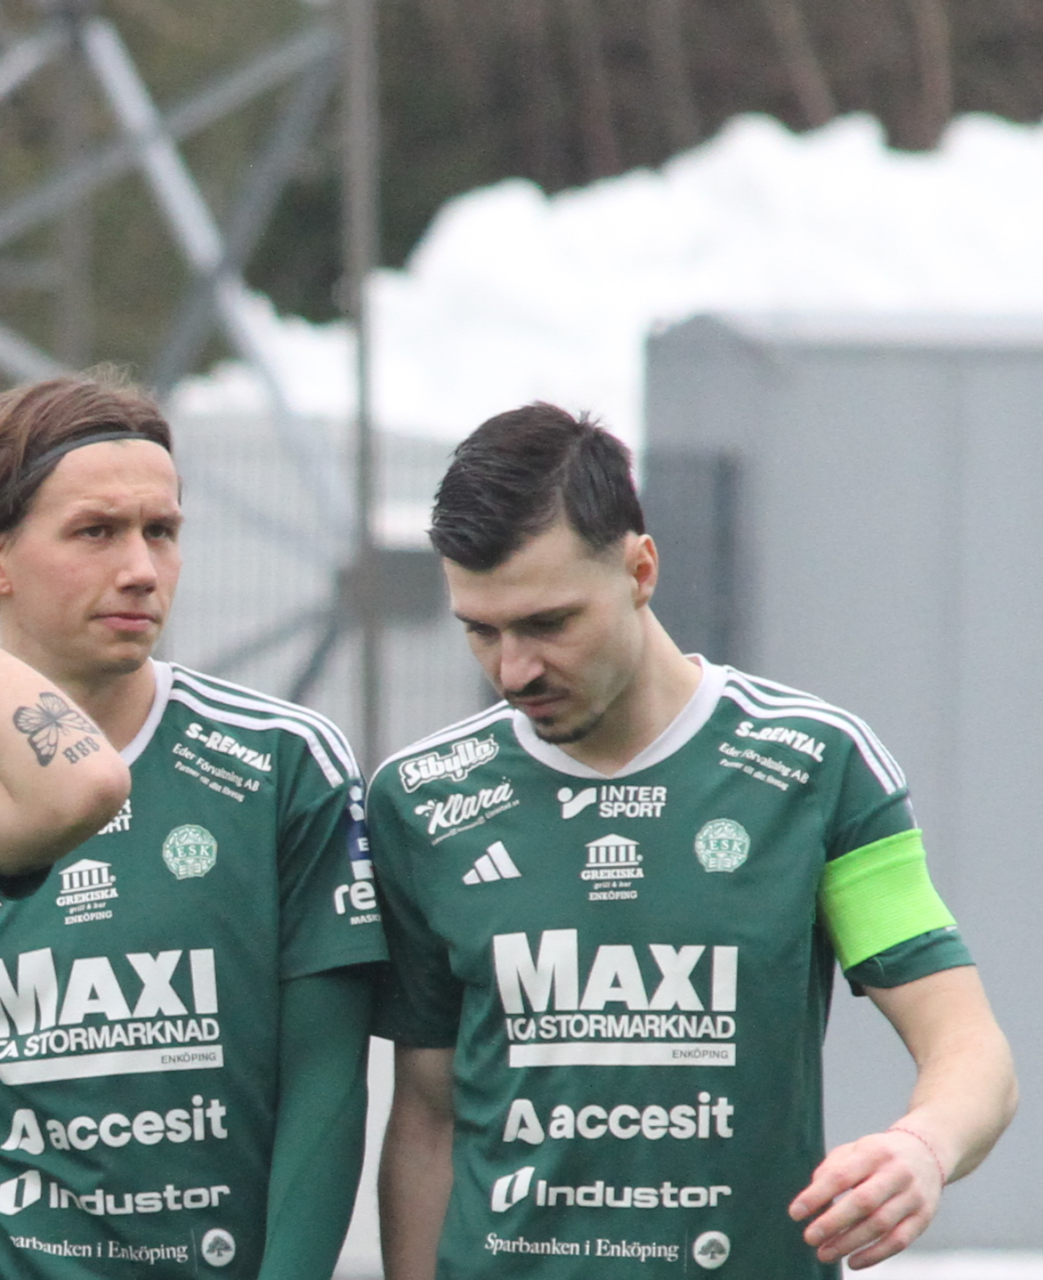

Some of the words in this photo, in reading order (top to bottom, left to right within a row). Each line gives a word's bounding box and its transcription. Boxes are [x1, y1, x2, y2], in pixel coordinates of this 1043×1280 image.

[599, 785, 667, 802] INTER
[599, 802, 666, 818] SPORT
[493, 928, 738, 1014] MAXI
[23, 1017, 220, 1057] STORMARKNAD
[506, 1018, 536, 1041] ICA
[539, 1013, 736, 1040] STORMARKNAD
[671, 1049, 729, 1060] ENKÖPING
[548, 1091, 735, 1140] accesit
[48, 1181, 231, 1216] Industor
[535, 1179, 732, 1209] Industor
[484, 1232, 580, 1256] Sparbanken
[584, 1240, 591, 1257] i
[595, 1238, 679, 1263] Enköping
